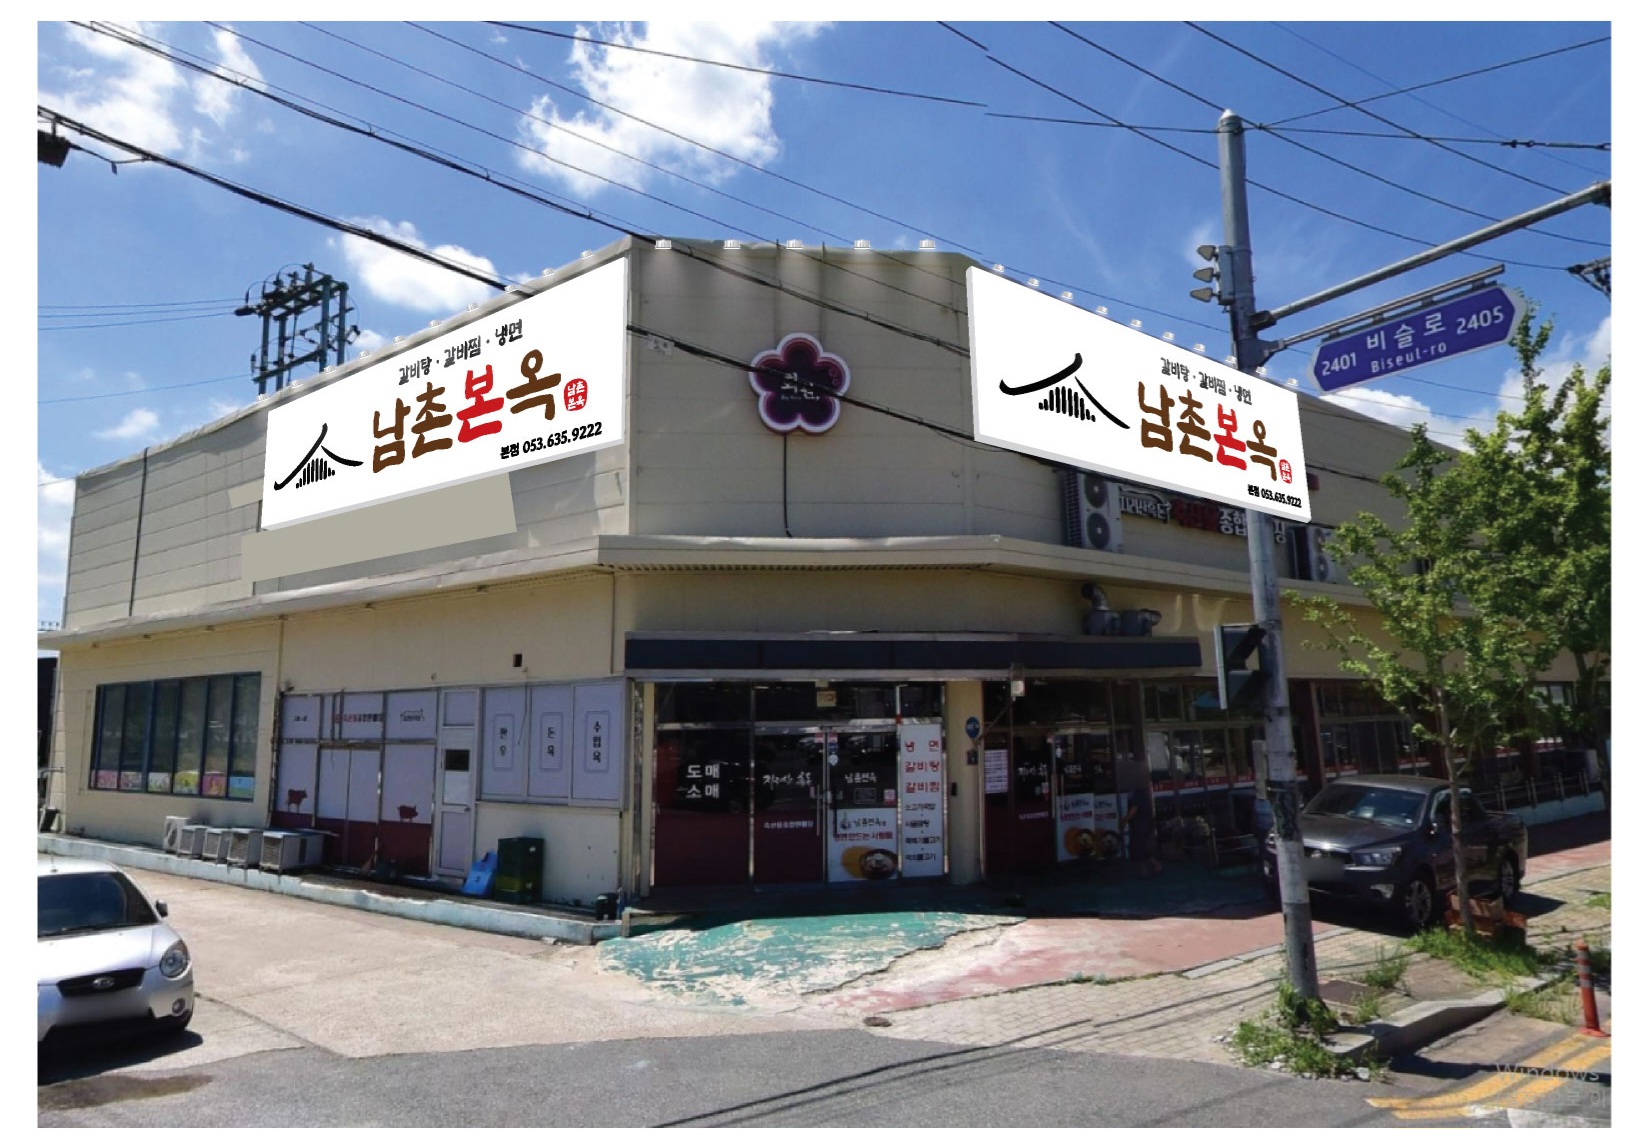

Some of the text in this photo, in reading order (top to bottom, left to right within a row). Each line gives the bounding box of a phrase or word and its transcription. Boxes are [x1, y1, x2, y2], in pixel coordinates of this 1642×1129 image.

[1366, 312, 1447, 351] 비슬로
[1456, 305, 1504, 335] 2405
[398, 319, 524, 386] 갈비탕 갈비찜 냉면
[1321, 351, 1357, 376] 2401
[1370, 341, 1447, 374] Biseul-ro
[1160, 357, 1253, 406] 갈비탕 갈비찜 냉면
[372, 348, 562, 474] 남촌본옥
[500, 421, 603, 460] 본점 053.635.9222
[1138, 381, 1278, 482] 남촌본옥
[1261, 487, 1303, 509] 053.635.9222
[686, 763, 721, 781] 도매
[904, 760, 940, 773] 갈비탕
[686, 783, 721, 799] 소매
[904, 781, 940, 794] 갈비찜
